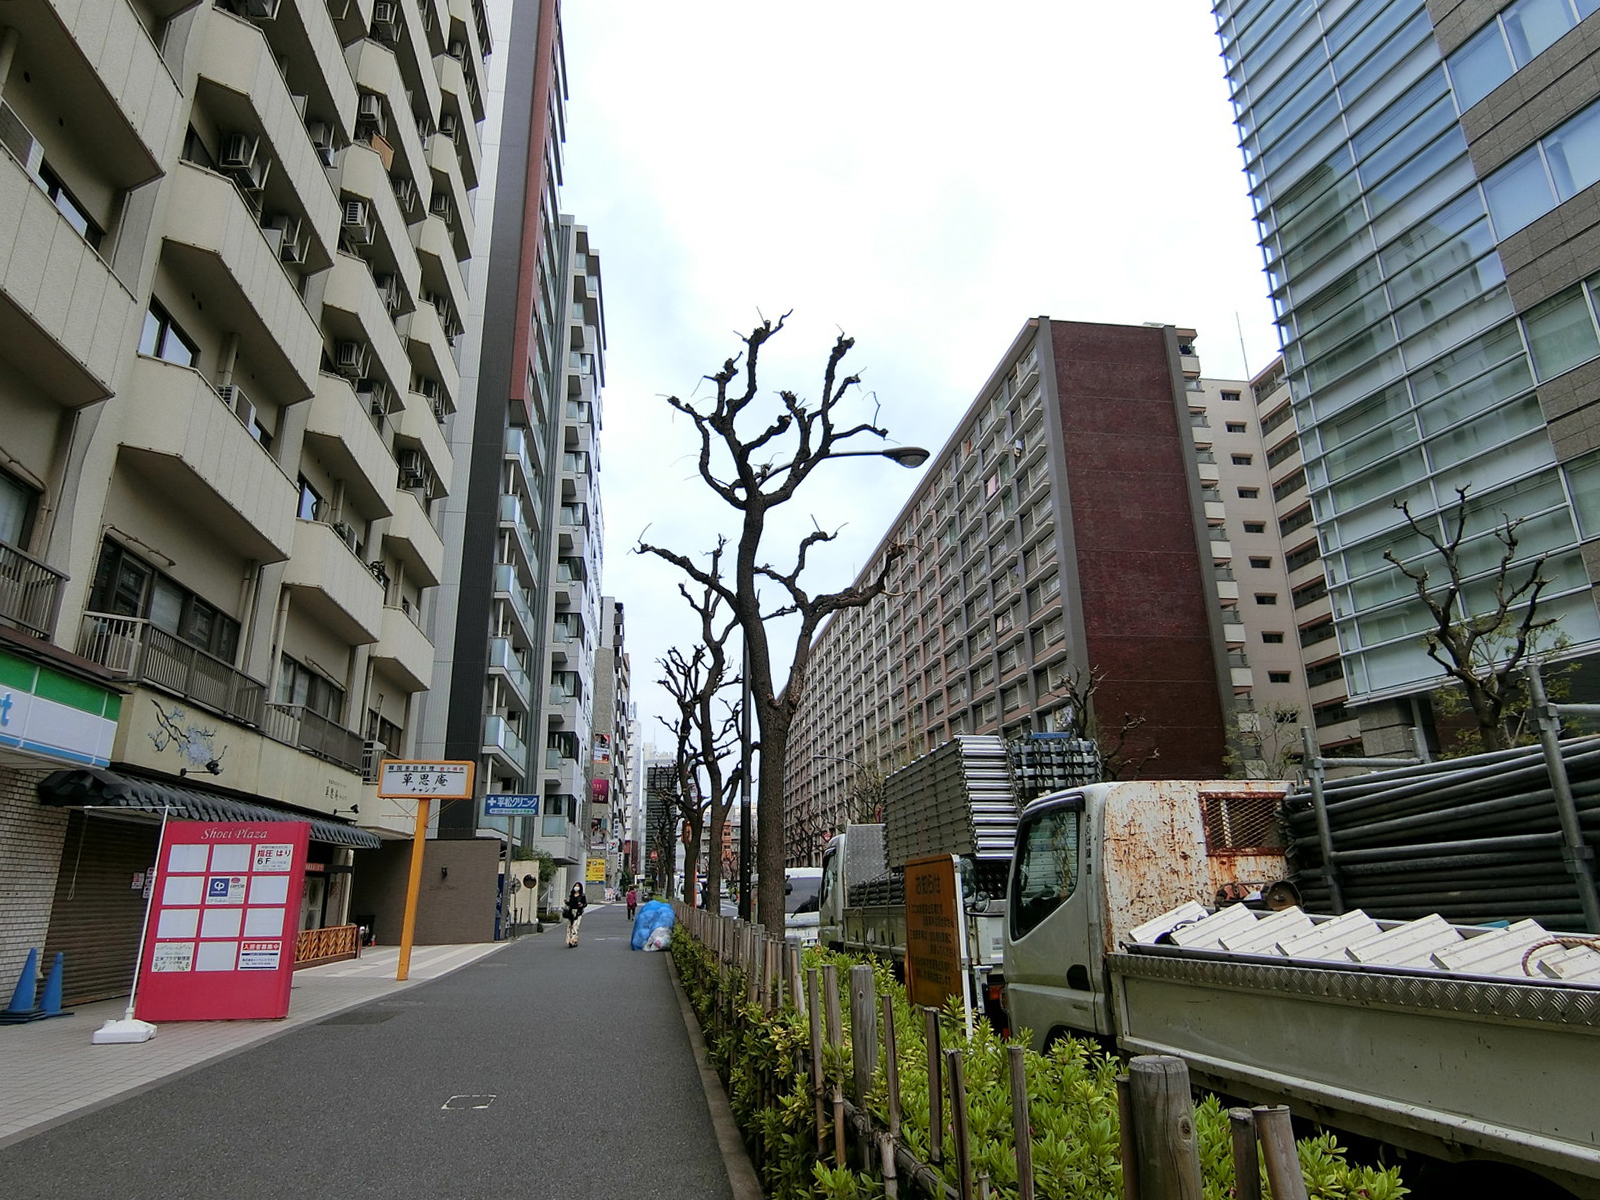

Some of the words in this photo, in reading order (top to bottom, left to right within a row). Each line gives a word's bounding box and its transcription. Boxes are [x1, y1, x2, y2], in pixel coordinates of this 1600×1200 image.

[497, 796, 538, 808] 平松クリニック
[235, 826, 268, 839] Plaza
[257, 849, 274, 858] 指圧
[276, 849, 291, 857] はり
[915, 874, 941, 895] お知らせ
